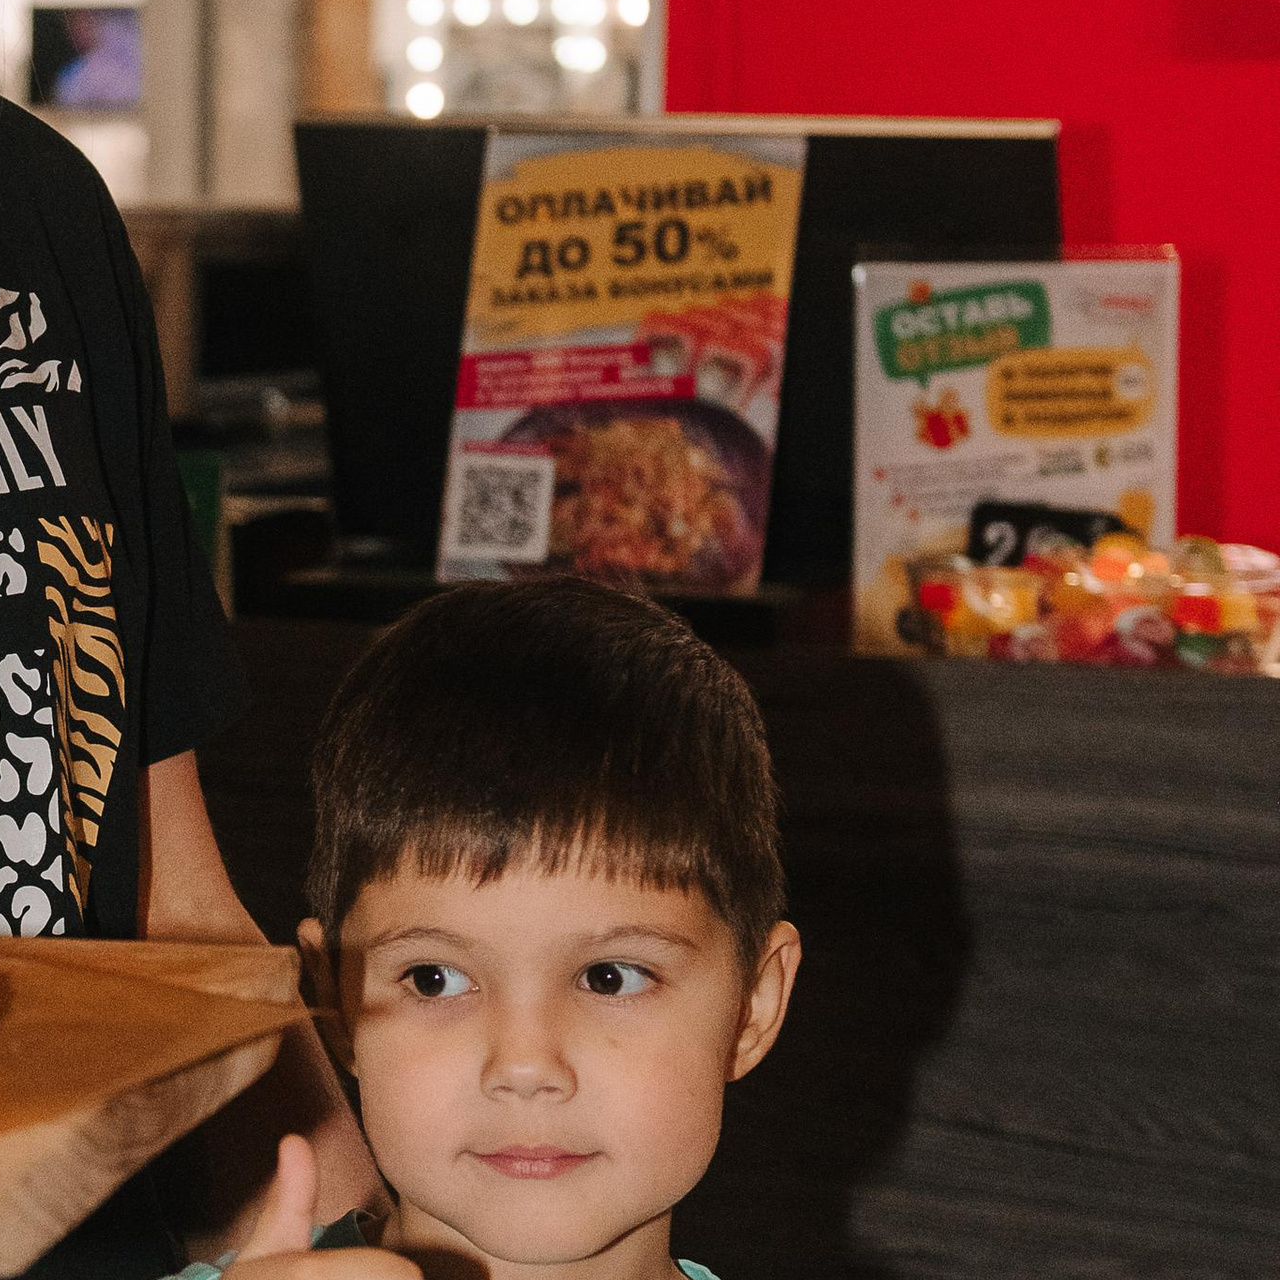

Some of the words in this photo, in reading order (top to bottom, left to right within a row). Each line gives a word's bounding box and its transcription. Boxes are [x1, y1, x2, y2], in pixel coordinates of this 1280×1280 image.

[496, 169, 773, 225] ОПЛАЧИВАЙ
[516, 236, 590, 278] ДО
[612, 219, 739, 266] 50%
[892, 293, 1033, 338] ОСТАВЬ
